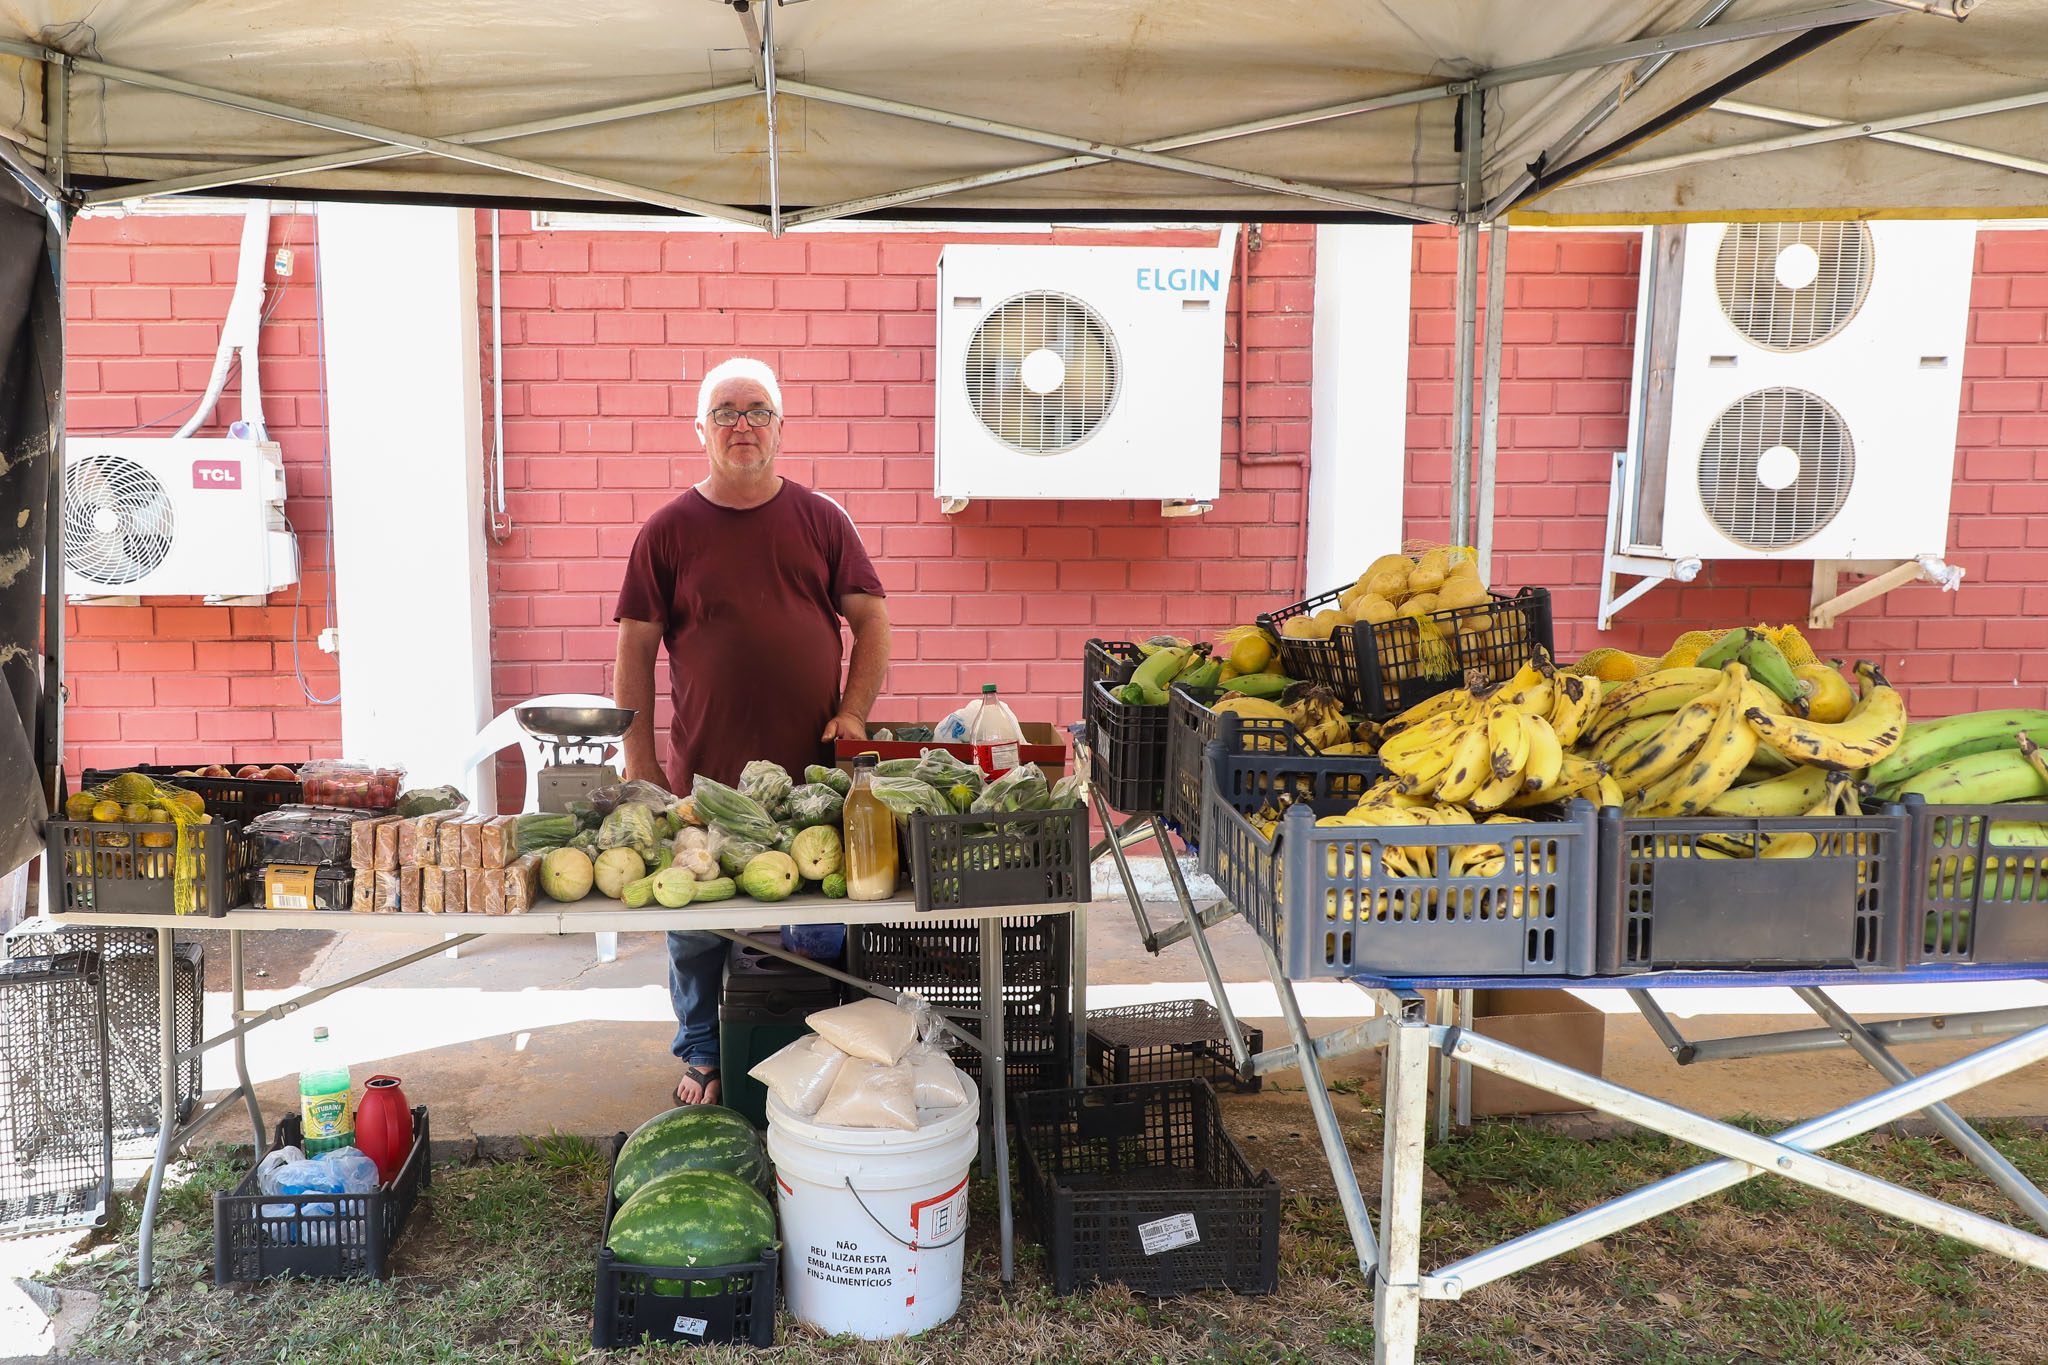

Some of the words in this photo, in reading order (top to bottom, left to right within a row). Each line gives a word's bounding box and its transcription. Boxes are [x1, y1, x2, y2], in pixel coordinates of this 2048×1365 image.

[1136, 268, 1219, 291] ELGIN
[198, 469, 236, 481] TCL
[810, 1245, 862, 1263] REUILIZAR
[836, 1241, 857, 1250] NÃO
[807, 1256, 863, 1275] EMBALAGEM
[865, 1267, 891, 1275] PARA
[807, 1267, 825, 1280] FINS
[825, 1274, 892, 1287] ALIMENTÍCIOS
